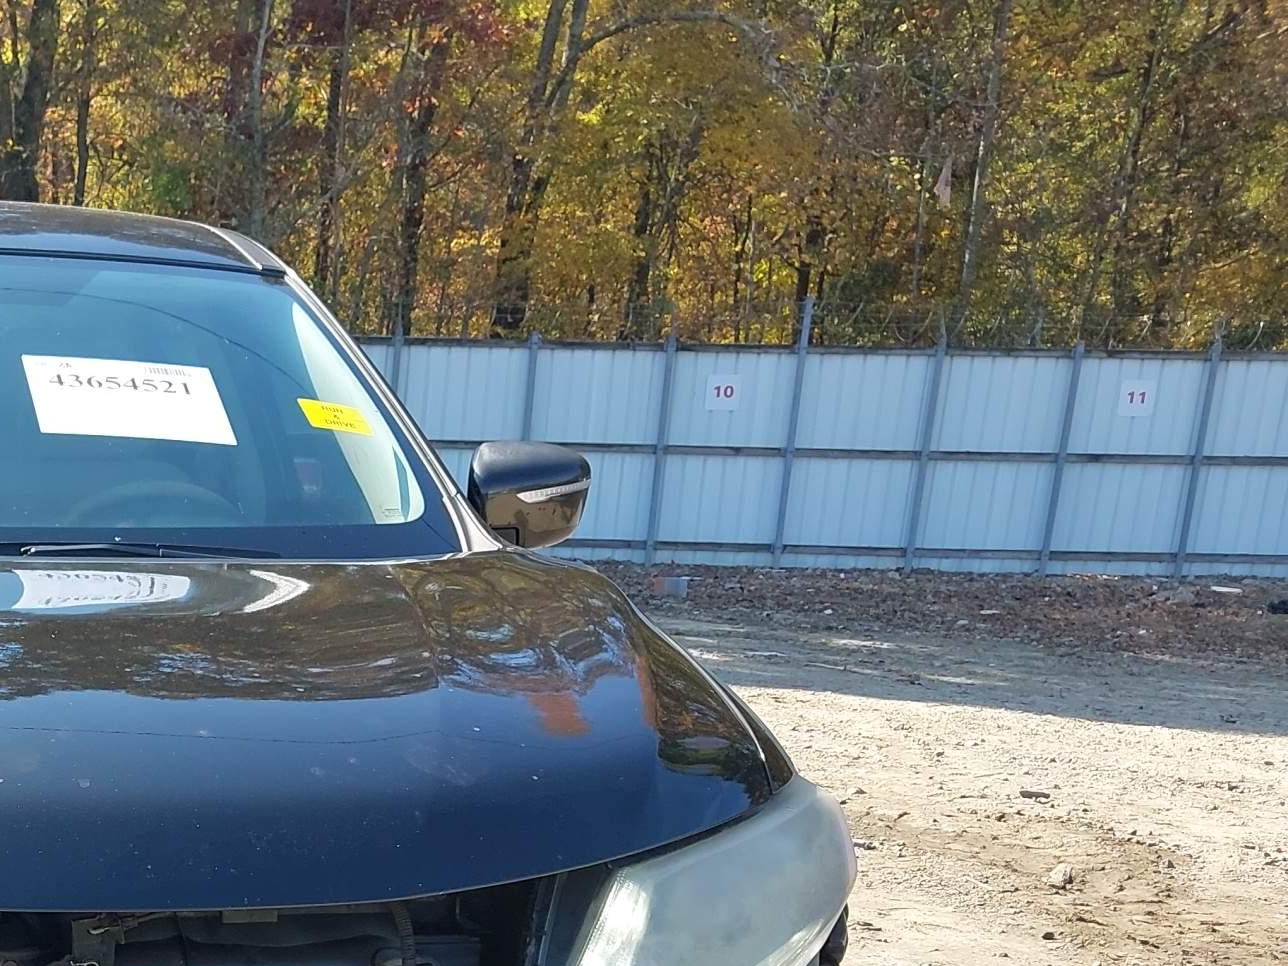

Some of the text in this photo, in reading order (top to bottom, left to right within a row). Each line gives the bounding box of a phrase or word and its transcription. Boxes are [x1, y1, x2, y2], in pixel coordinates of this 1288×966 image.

[48, 373, 192, 396] 43654521
[713, 384, 734, 399] 10
[1127, 391, 1146, 405] 11
